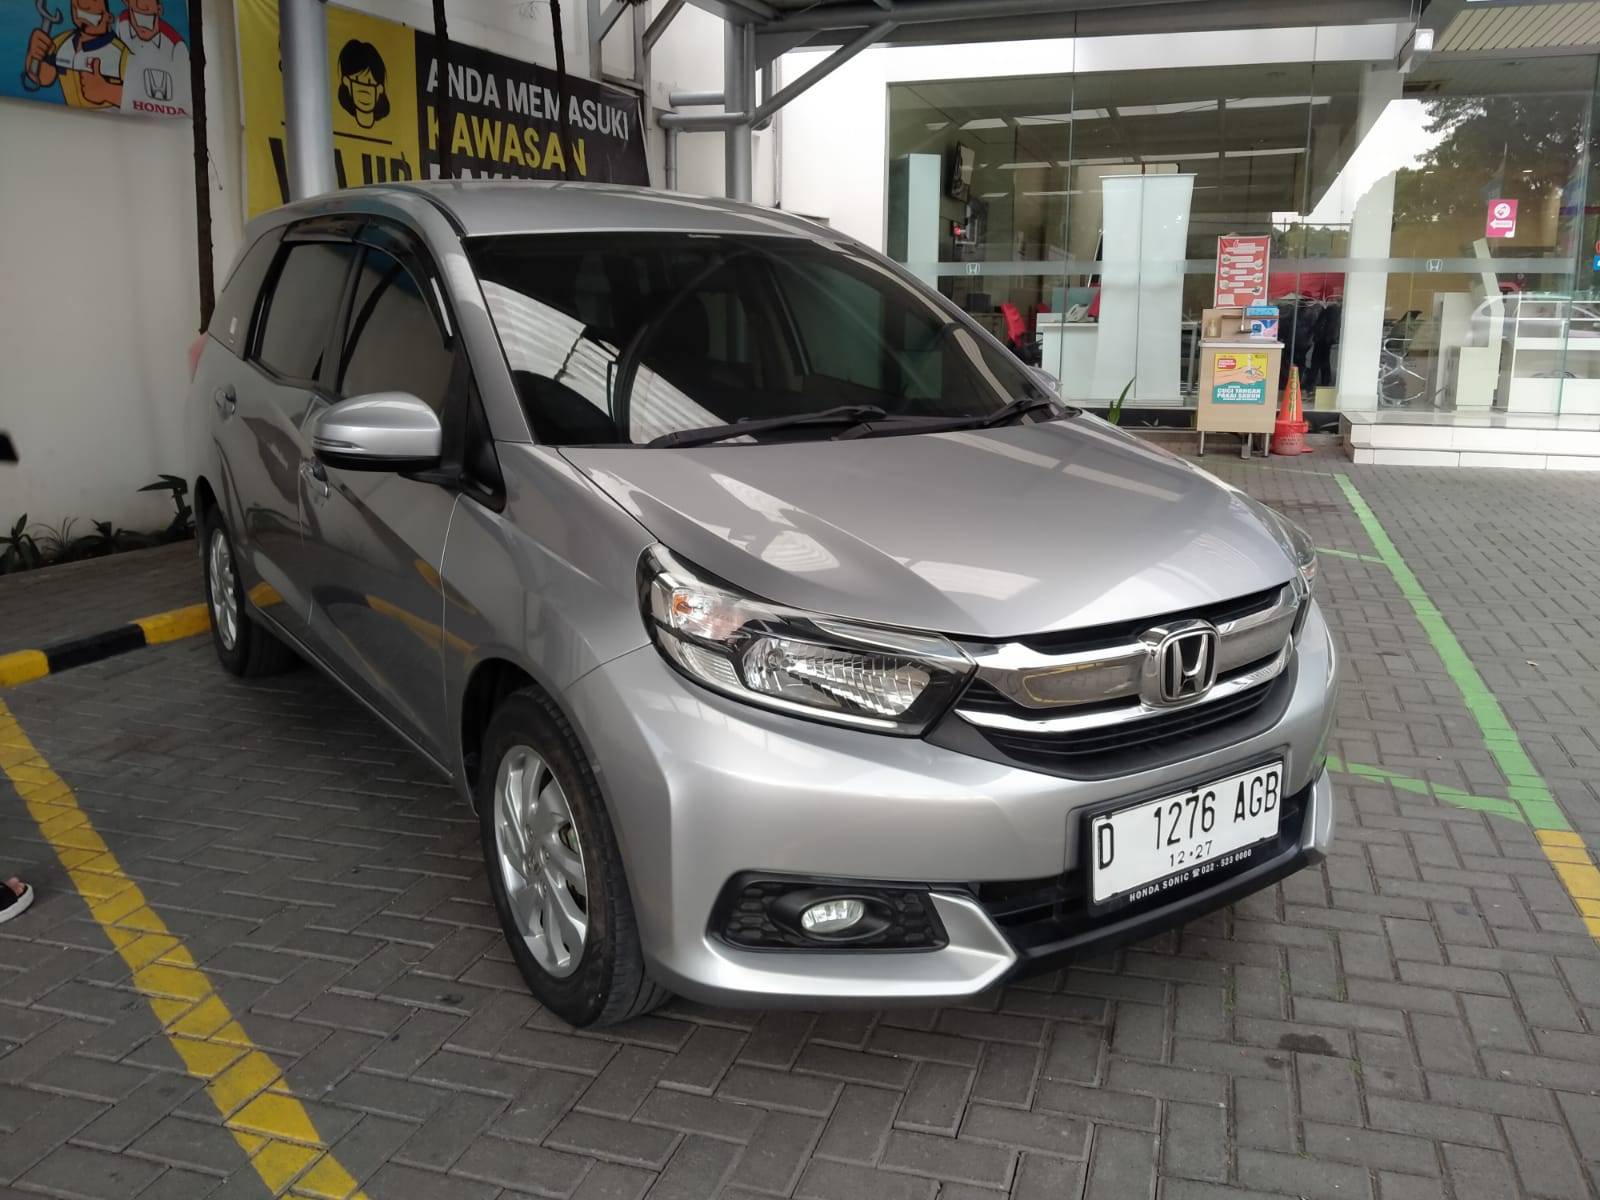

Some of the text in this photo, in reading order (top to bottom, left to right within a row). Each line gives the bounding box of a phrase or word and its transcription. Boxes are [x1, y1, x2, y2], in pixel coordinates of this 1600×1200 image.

[132, 100, 187, 116] HONDA
[427, 58, 630, 141] ANDA MEMASUKI
[427, 105, 587, 177] KAWASAN
[1098, 770, 1279, 870] D 1276 AGB
[1129, 884, 1160, 902] HONDA
[1162, 872, 1190, 890] SONIC
[1201, 862, 1215, 875] 022
